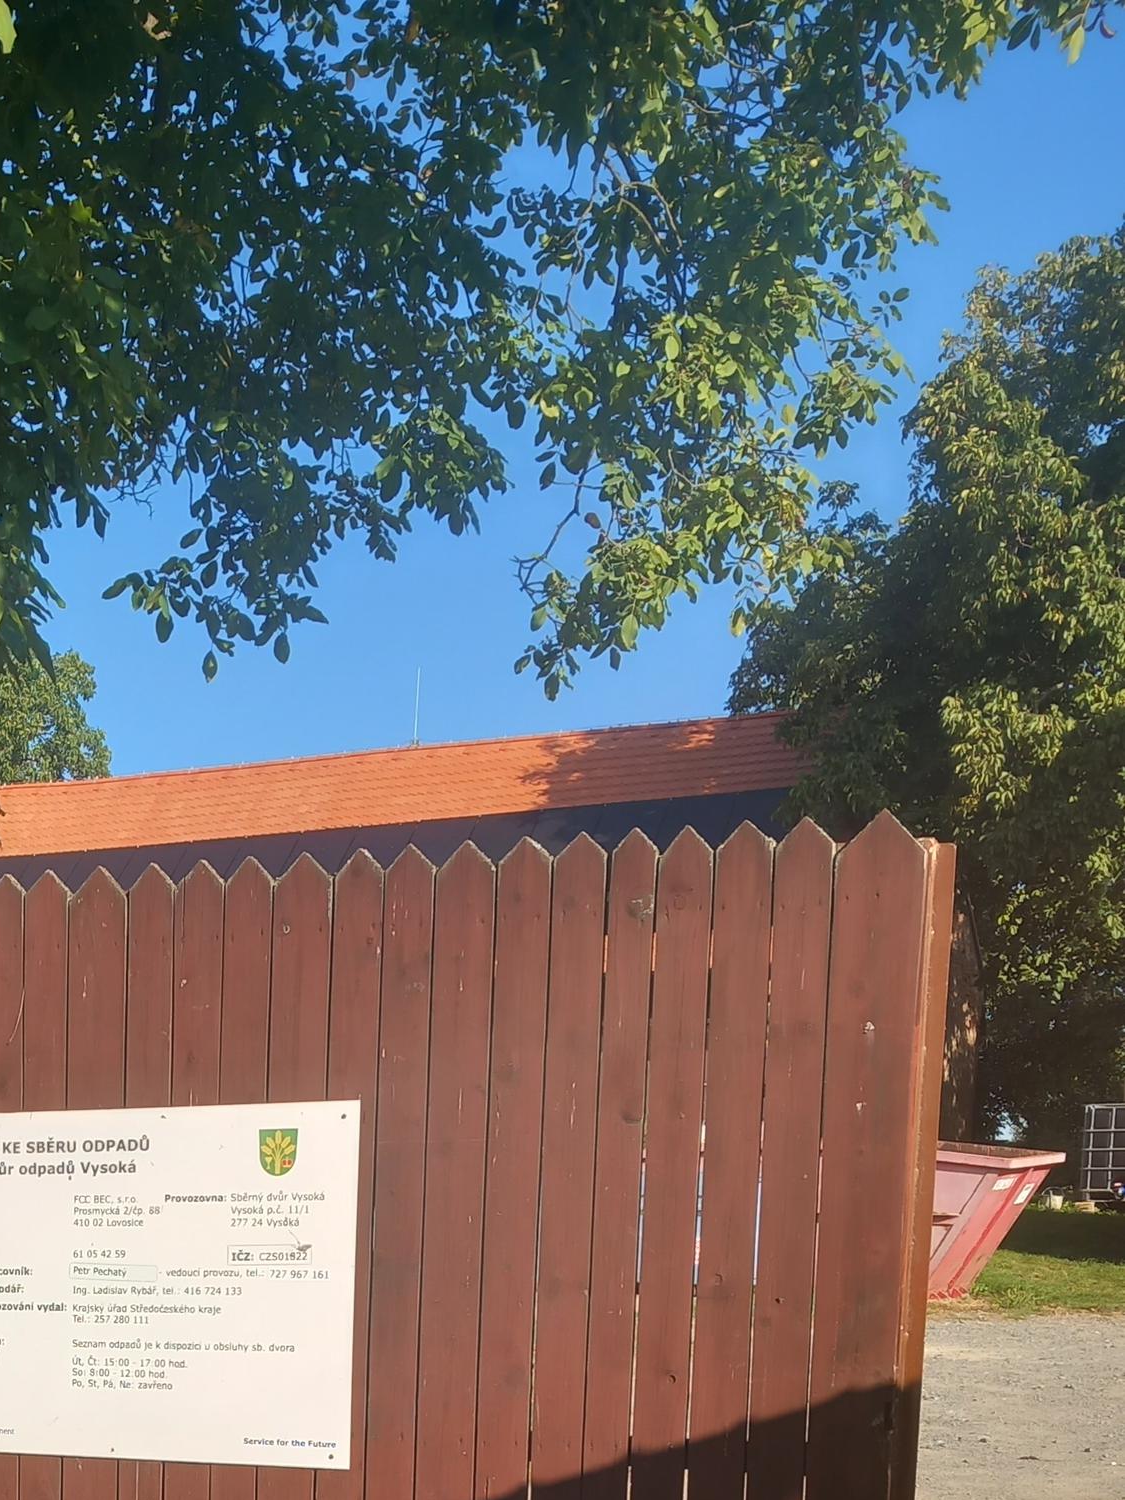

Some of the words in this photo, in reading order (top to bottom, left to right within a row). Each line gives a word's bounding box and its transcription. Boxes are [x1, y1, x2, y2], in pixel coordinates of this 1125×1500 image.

[3, 1142, 21, 1154] KE
[26, 1137, 76, 1154] SBĚRU
[82, 1135, 150, 1153] ODPADŮ
[19, 1160, 75, 1177] odpadů
[81, 1159, 137, 1177] Vysoká
[74, 1195, 91, 1204] FCC
[94, 1195, 114, 1205] BEC,
[165, 1194, 227, 1203] Provozovna:
[231, 1192, 263, 1204] Sběrný
[267, 1190, 288, 1202] dvůr
[291, 1192, 325, 1204] Vysoká
[74, 1206, 120, 1217] Prosmycká
[231, 1205, 264, 1216] Vysoká
[74, 1218, 90, 1227] 410
[93, 1218, 104, 1227] 02
[107, 1218, 144, 1227] Lovosice
[231, 1218, 248, 1227] 277
[251, 1218, 263, 1227] 24
[267, 1218, 300, 1228] Vysoká
[73, 1250, 83, 1258] 61
[87, 1250, 98, 1258] 05
[101, 1250, 112, 1258] 42
[115, 1250, 126, 1258] 59
[231, 1250, 254, 1261] IČZ:
[73, 1266, 90, 1275] Petr
[203, 1269, 243, 1280] provozu,
[270, 1270, 287, 1279] 727
[291, 1270, 309, 1279] 967
[313, 1270, 330, 1280] 161
[73, 1286, 90, 1296] Ing.
[93, 1286, 127, 1295] Ladislav
[131, 1286, 159, 1297] Rybář,
[184, 1287, 201, 1296] 416
[205, 1287, 221, 1296] 724
[225, 1287, 243, 1296] 133
[37, 1302, 68, 1313] vydal:
[73, 1304, 105, 1314] Krajský
[107, 1304, 127, 1313] úřad
[131, 1304, 195, 1314] Středočeského
[199, 1305, 222, 1315] kraje
[94, 1316, 110, 1324] 257
[113, 1316, 130, 1324] 280
[133, 1316, 149, 1324] 111
[72, 1339, 107, 1349] Seznam
[109, 1338, 142, 1350] odpadů
[144, 1340, 153, 1351] je
[156, 1341, 161, 1350] k
[164, 1341, 202, 1352] dispozici
[213, 1342, 248, 1353] obsluhy
[252, 1342, 266, 1352] sb.
[269, 1343, 296, 1353] dvora
[72, 1355, 85, 1367] Út,
[105, 1358, 130, 1367] 15:00
[169, 1359, 188, 1369] hod.
[72, 1379, 85, 1390] Po,
[88, 1380, 100, 1390] St,
[103, 1379, 116, 1390] Pá,
[138, 1379, 173, 1391] zavřeno
[243, 1438, 275, 1446] Service
[277, 1439, 290, 1447] for
[308, 1440, 337, 1449] Future
